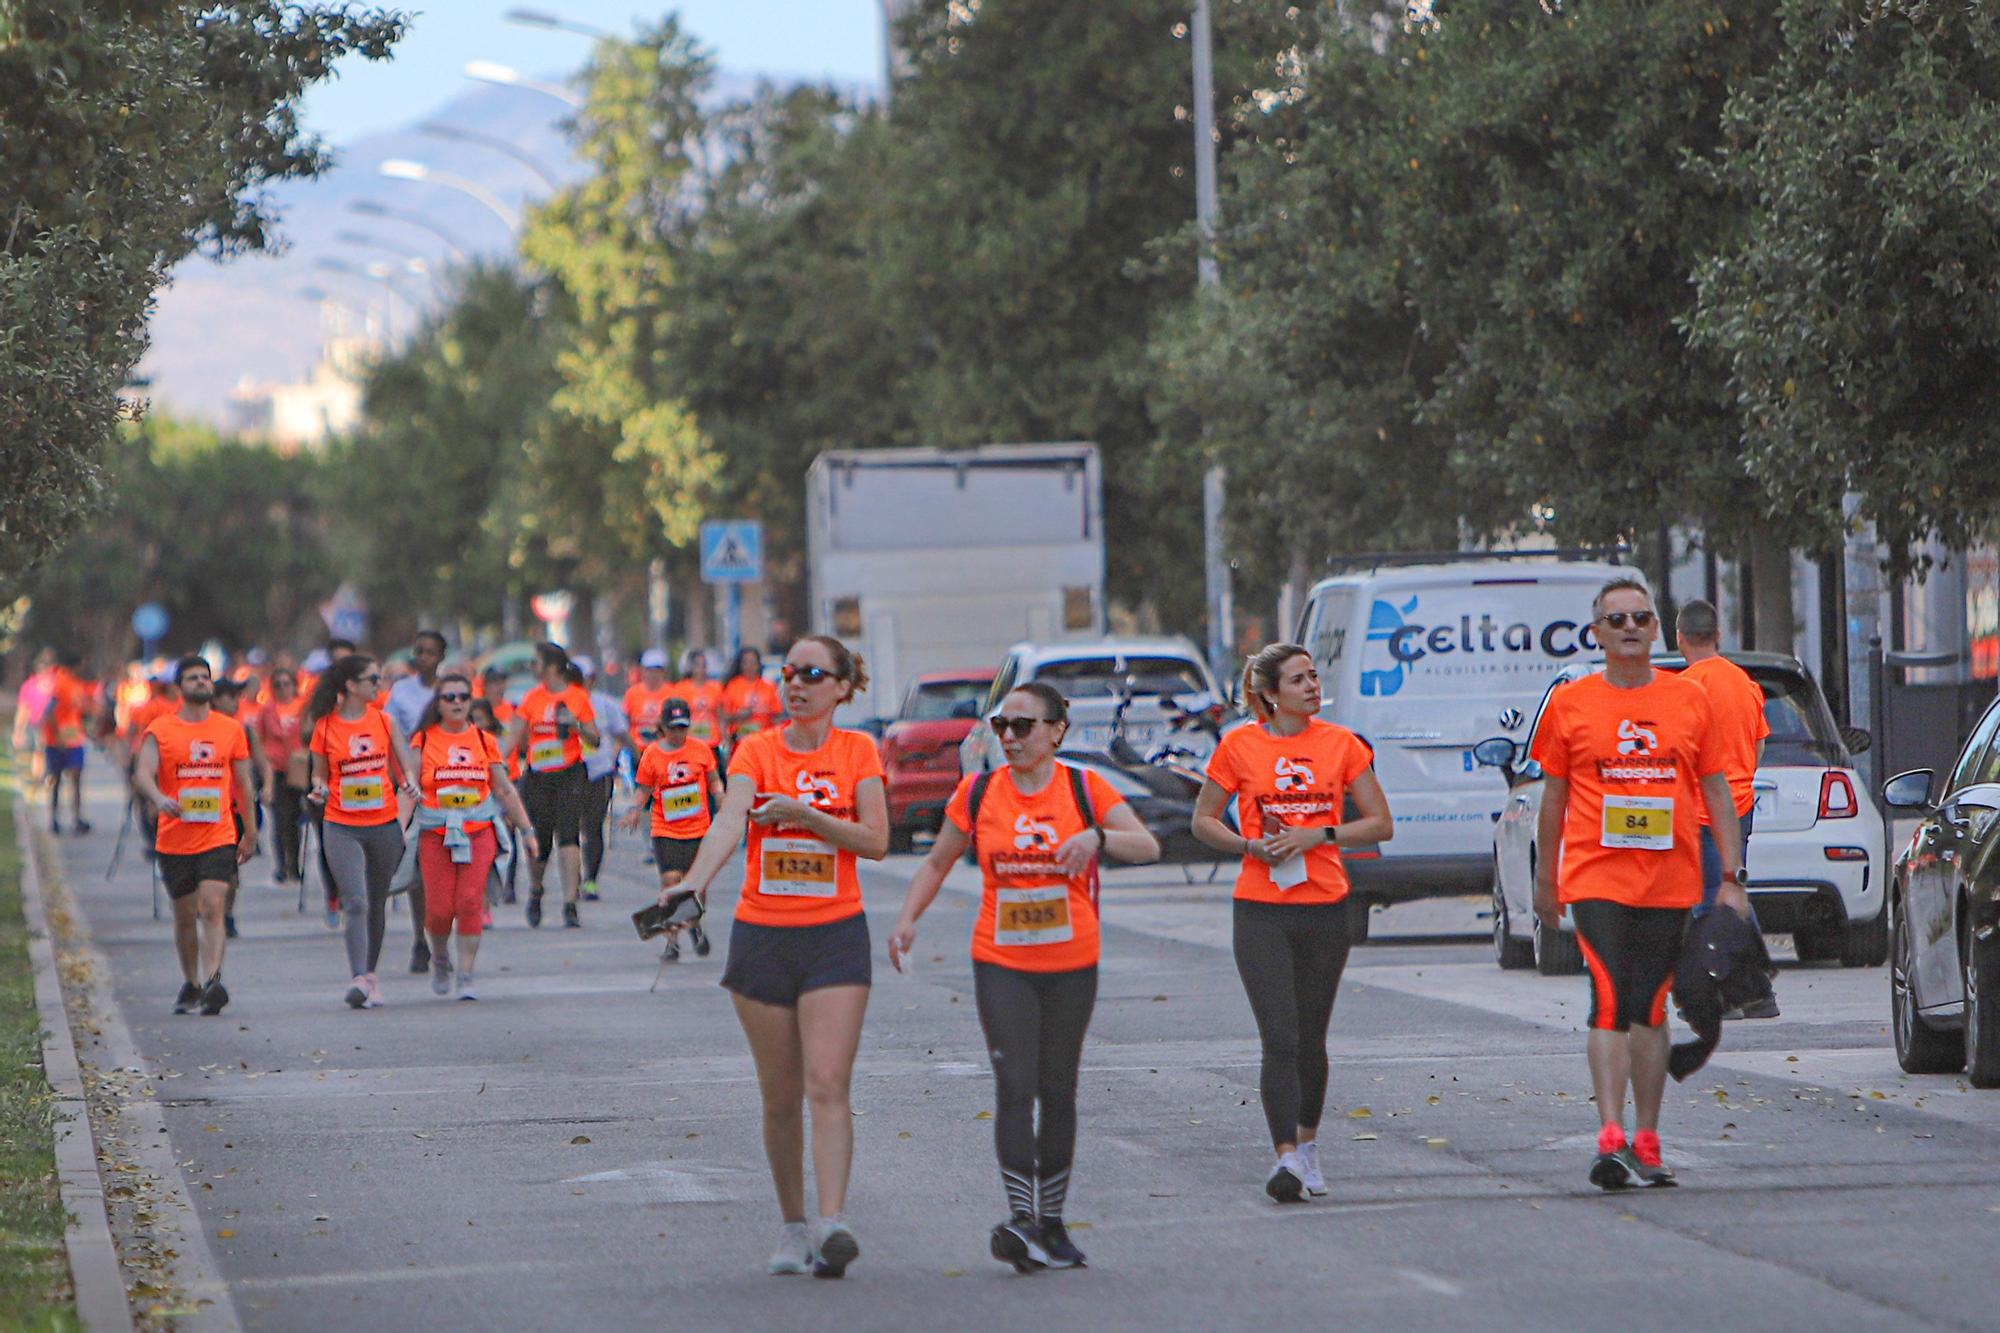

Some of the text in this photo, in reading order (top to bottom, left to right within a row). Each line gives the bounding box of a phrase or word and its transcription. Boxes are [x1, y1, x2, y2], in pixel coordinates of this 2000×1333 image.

[1601, 768, 1677, 779] PROSOLIA
[1395, 812, 1484, 823] ww.celtacar.com
[1626, 815, 1649, 830] 84
[775, 857, 823, 876] 1324
[1010, 906, 1056, 925] 1325
